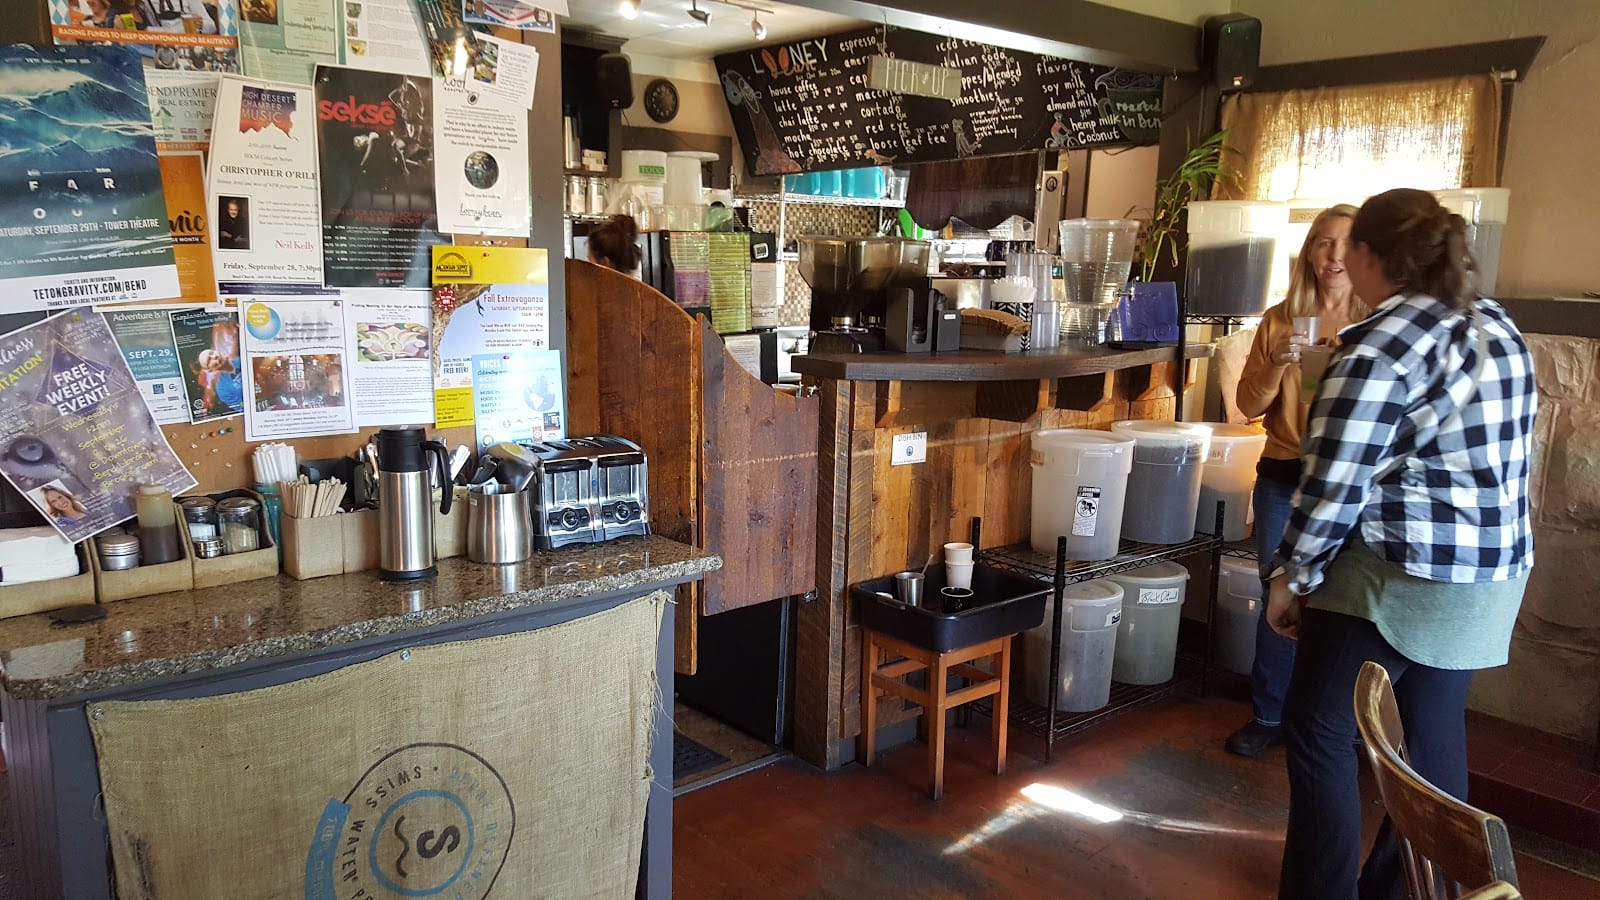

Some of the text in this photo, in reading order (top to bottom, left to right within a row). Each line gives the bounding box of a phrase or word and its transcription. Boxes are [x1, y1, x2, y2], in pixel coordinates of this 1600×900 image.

[58, 27, 87, 37] RAISING
[86, 30, 110, 38] FUNDS
[111, 31, 120, 39] TO
[120, 32, 137, 40] KEEP
[138, 33, 179, 42] DOWNTOWN
[179, 35, 197, 43] BEND
[839, 36, 877, 54] espresso
[935, 38, 959, 52] iced
[940, 47, 1008, 69] italian soda
[885, 58, 950, 96] PICK UP
[1036, 62, 1074, 76] flavor
[768, 85, 792, 97] house
[794, 80, 818, 94] coffee
[1042, 74, 1086, 96] soy milk
[261, 93, 290, 103] DESERT
[774, 99, 798, 113] latte
[950, 87, 1001, 108] smoothies
[1046, 91, 1099, 112] almond milk
[1115, 98, 1161, 112] roasted
[242, 108, 281, 123] MUSIC
[860, 100, 901, 118] cortado
[779, 116, 796, 128] chai
[796, 111, 820, 125] latte
[865, 119, 884, 134] red
[890, 122, 909, 133] eye
[1069, 113, 1121, 134] hemp milk
[1121, 113, 1162, 129] in Ben
[783, 129, 813, 143] mocha
[869, 131, 947, 151] loose leaf tea
[1078, 126, 1121, 145] Coconut
[787, 140, 849, 158] hot chocolate
[220, 165, 284, 178] CHRISTOPHER
[0, 218, 160, 237] ATURDAY, SEPTEMBER 29TH TOWER THEATRE
[275, 239, 314, 252] Neil Kelly
[223, 262, 247, 270] Friday,
[248, 263, 285, 271] September
[33, 279, 147, 300] TETONGRAVITY.COM/BEND
[484, 294, 544, 305] Fall Extravaganza
[113, 311, 153, 322] Adventure
[154, 311, 161, 319] Is
[128, 348, 174, 360] SEPT. 29,
[54, 362, 91, 387] FREE
[443, 367, 454, 375] FREE
[46, 368, 107, 406] WEEKLY
[56, 385, 111, 417] EVENT!
[78, 424, 126, 450] September
[101, 441, 145, 465] Downtown
[366, 766, 422, 809] SWISS
[342, 820, 366, 882] WATER
